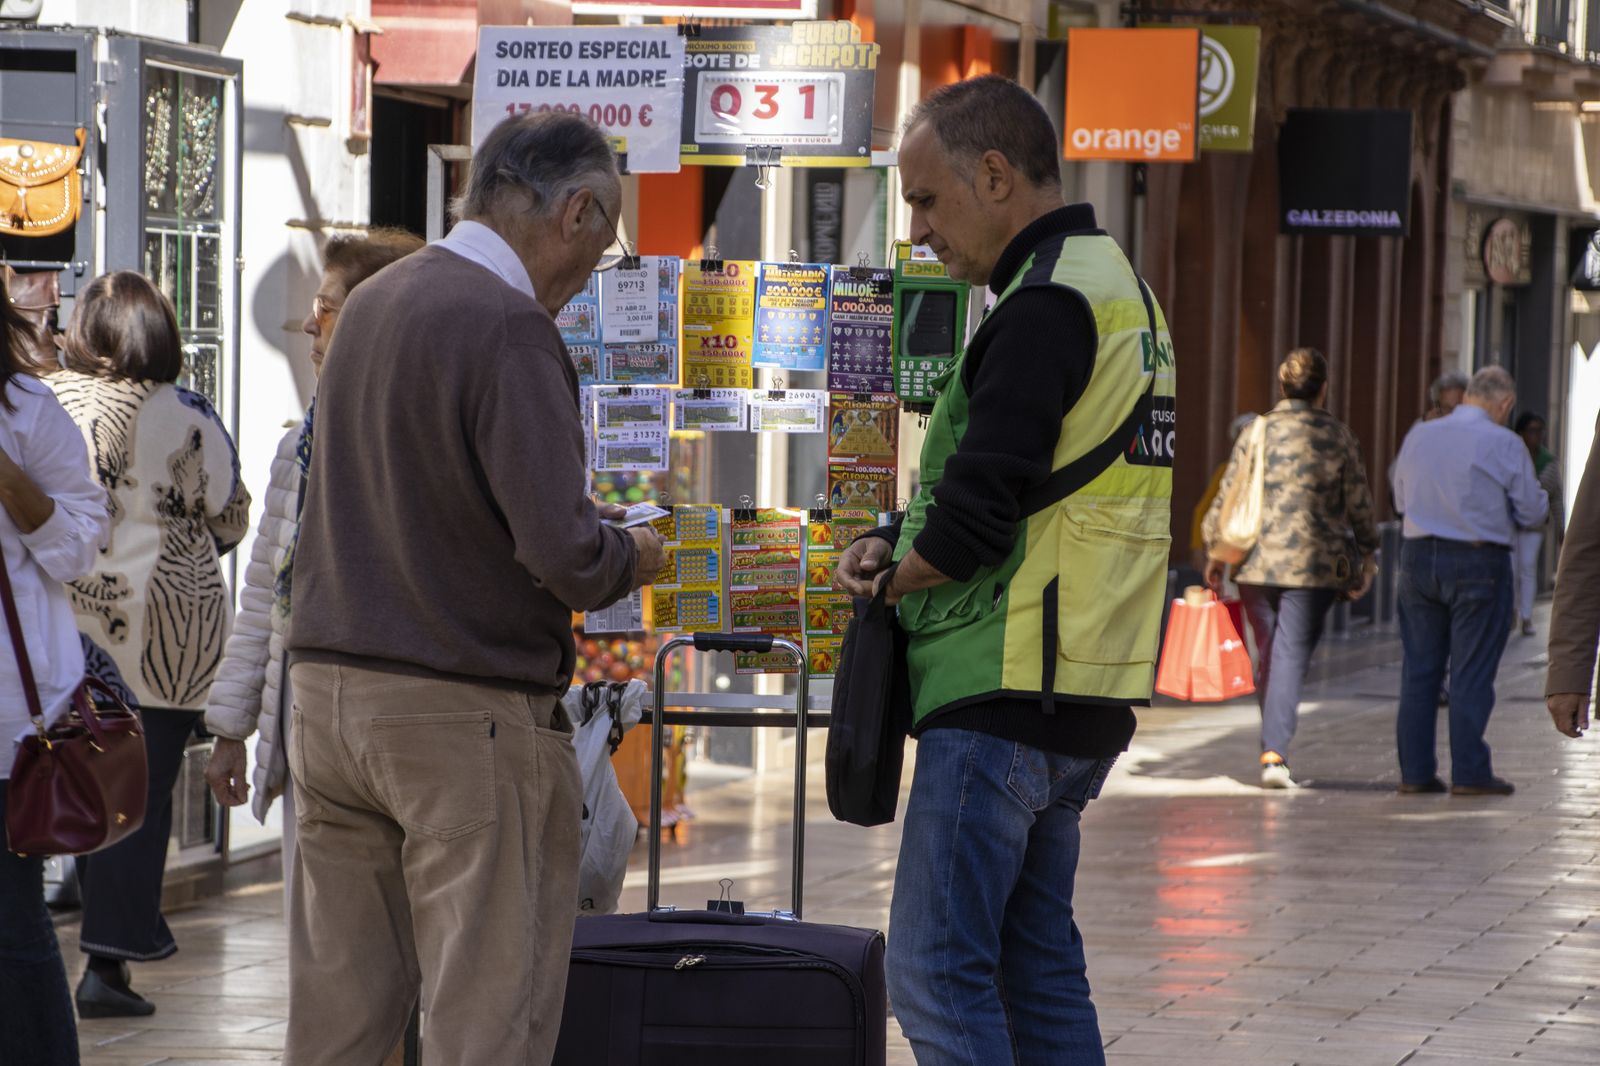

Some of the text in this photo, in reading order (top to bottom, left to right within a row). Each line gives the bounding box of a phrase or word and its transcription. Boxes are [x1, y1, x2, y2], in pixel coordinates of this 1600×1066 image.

[793, 22, 851, 43] EURO
[496, 40, 671, 59] SORTEO ESPECIAL
[684, 53, 761, 68] BOTE DE
[496, 69, 667, 88] DIA DE LA MADRE
[638, 103, 653, 127] €
[1201, 125, 1240, 137] CHER
[1072, 127, 1181, 157] orange
[1286, 209, 1401, 227] CALZEDONIA
[618, 281, 645, 289] 69713
[833, 301, 893, 314] 1.000.000
[843, 401, 885, 410] CLEOPATRA
[842, 473, 883, 481] CLEOPATRA
[855, 466, 887, 474] 100.000€
